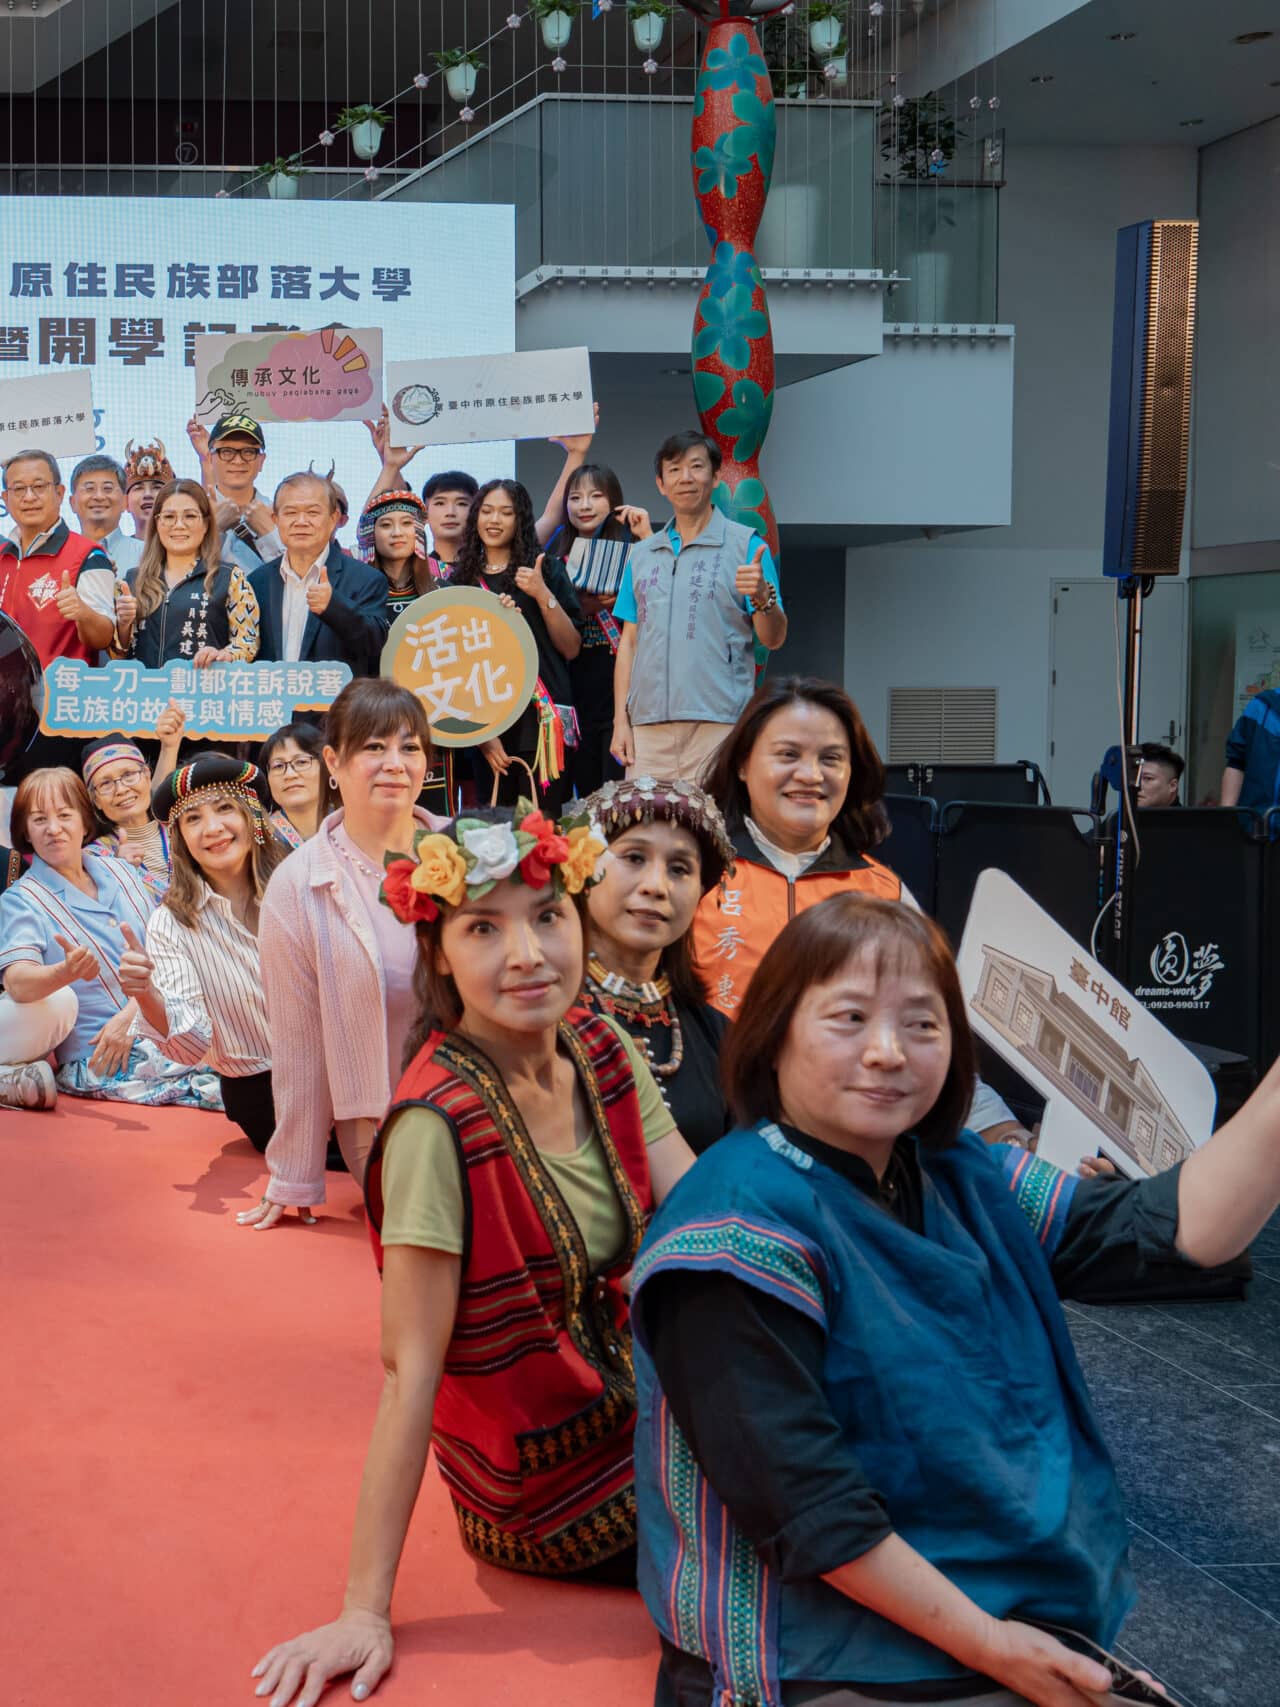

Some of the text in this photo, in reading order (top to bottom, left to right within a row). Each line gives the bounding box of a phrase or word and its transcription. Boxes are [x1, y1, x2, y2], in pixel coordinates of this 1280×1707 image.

[230, 366, 321, 388] 傳承文化
[448, 389, 584, 411] 臺中市原住民族部落大學
[221, 415, 258, 431] 46
[405, 614, 492, 672] 活出
[54, 664, 344, 696] 每一刀一劃都在訴說著
[414, 659, 514, 724] 文化
[54, 695, 286, 727] 民族的故事與情感
[1068, 956, 1132, 1032] 臺中館
[1134, 985, 1197, 996] dreams-work
